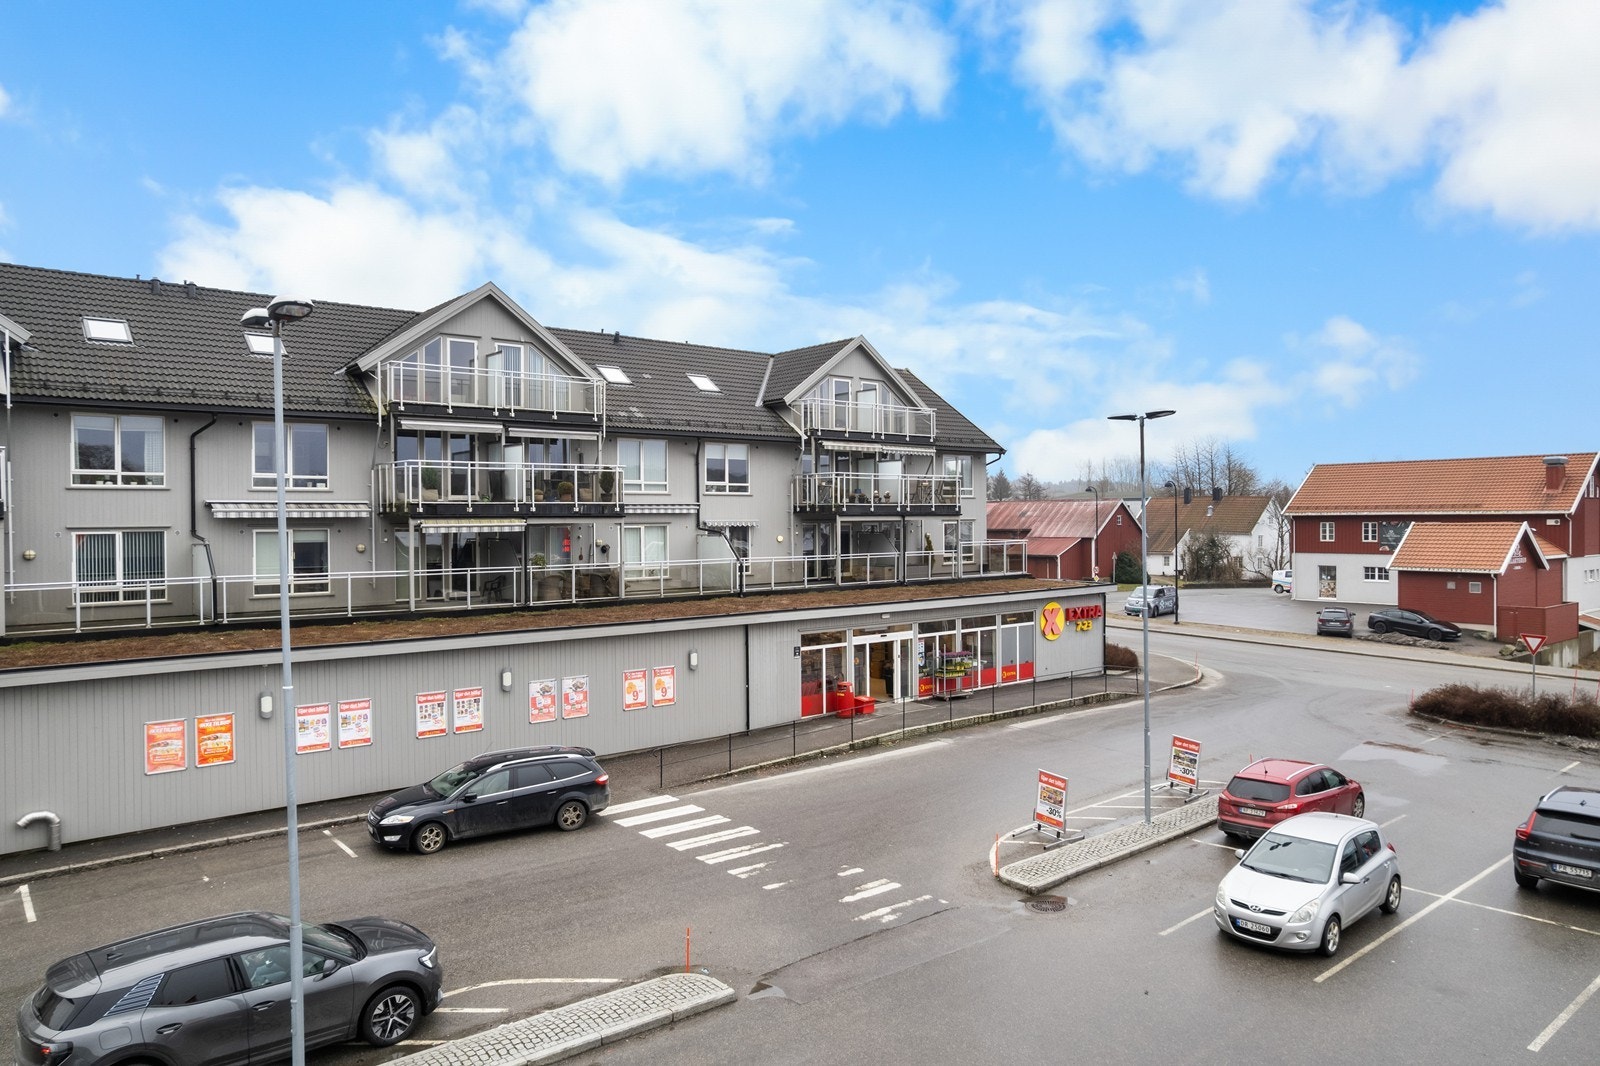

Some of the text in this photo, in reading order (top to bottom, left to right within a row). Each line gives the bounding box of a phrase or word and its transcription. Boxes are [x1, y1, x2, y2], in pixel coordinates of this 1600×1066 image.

[1065, 605, 1103, 621] EXTRA
[1180, 767, 1195, 777] -30%
[1046, 807, 1062, 818] -30%
[1251, 923, 1270, 933] 25060
